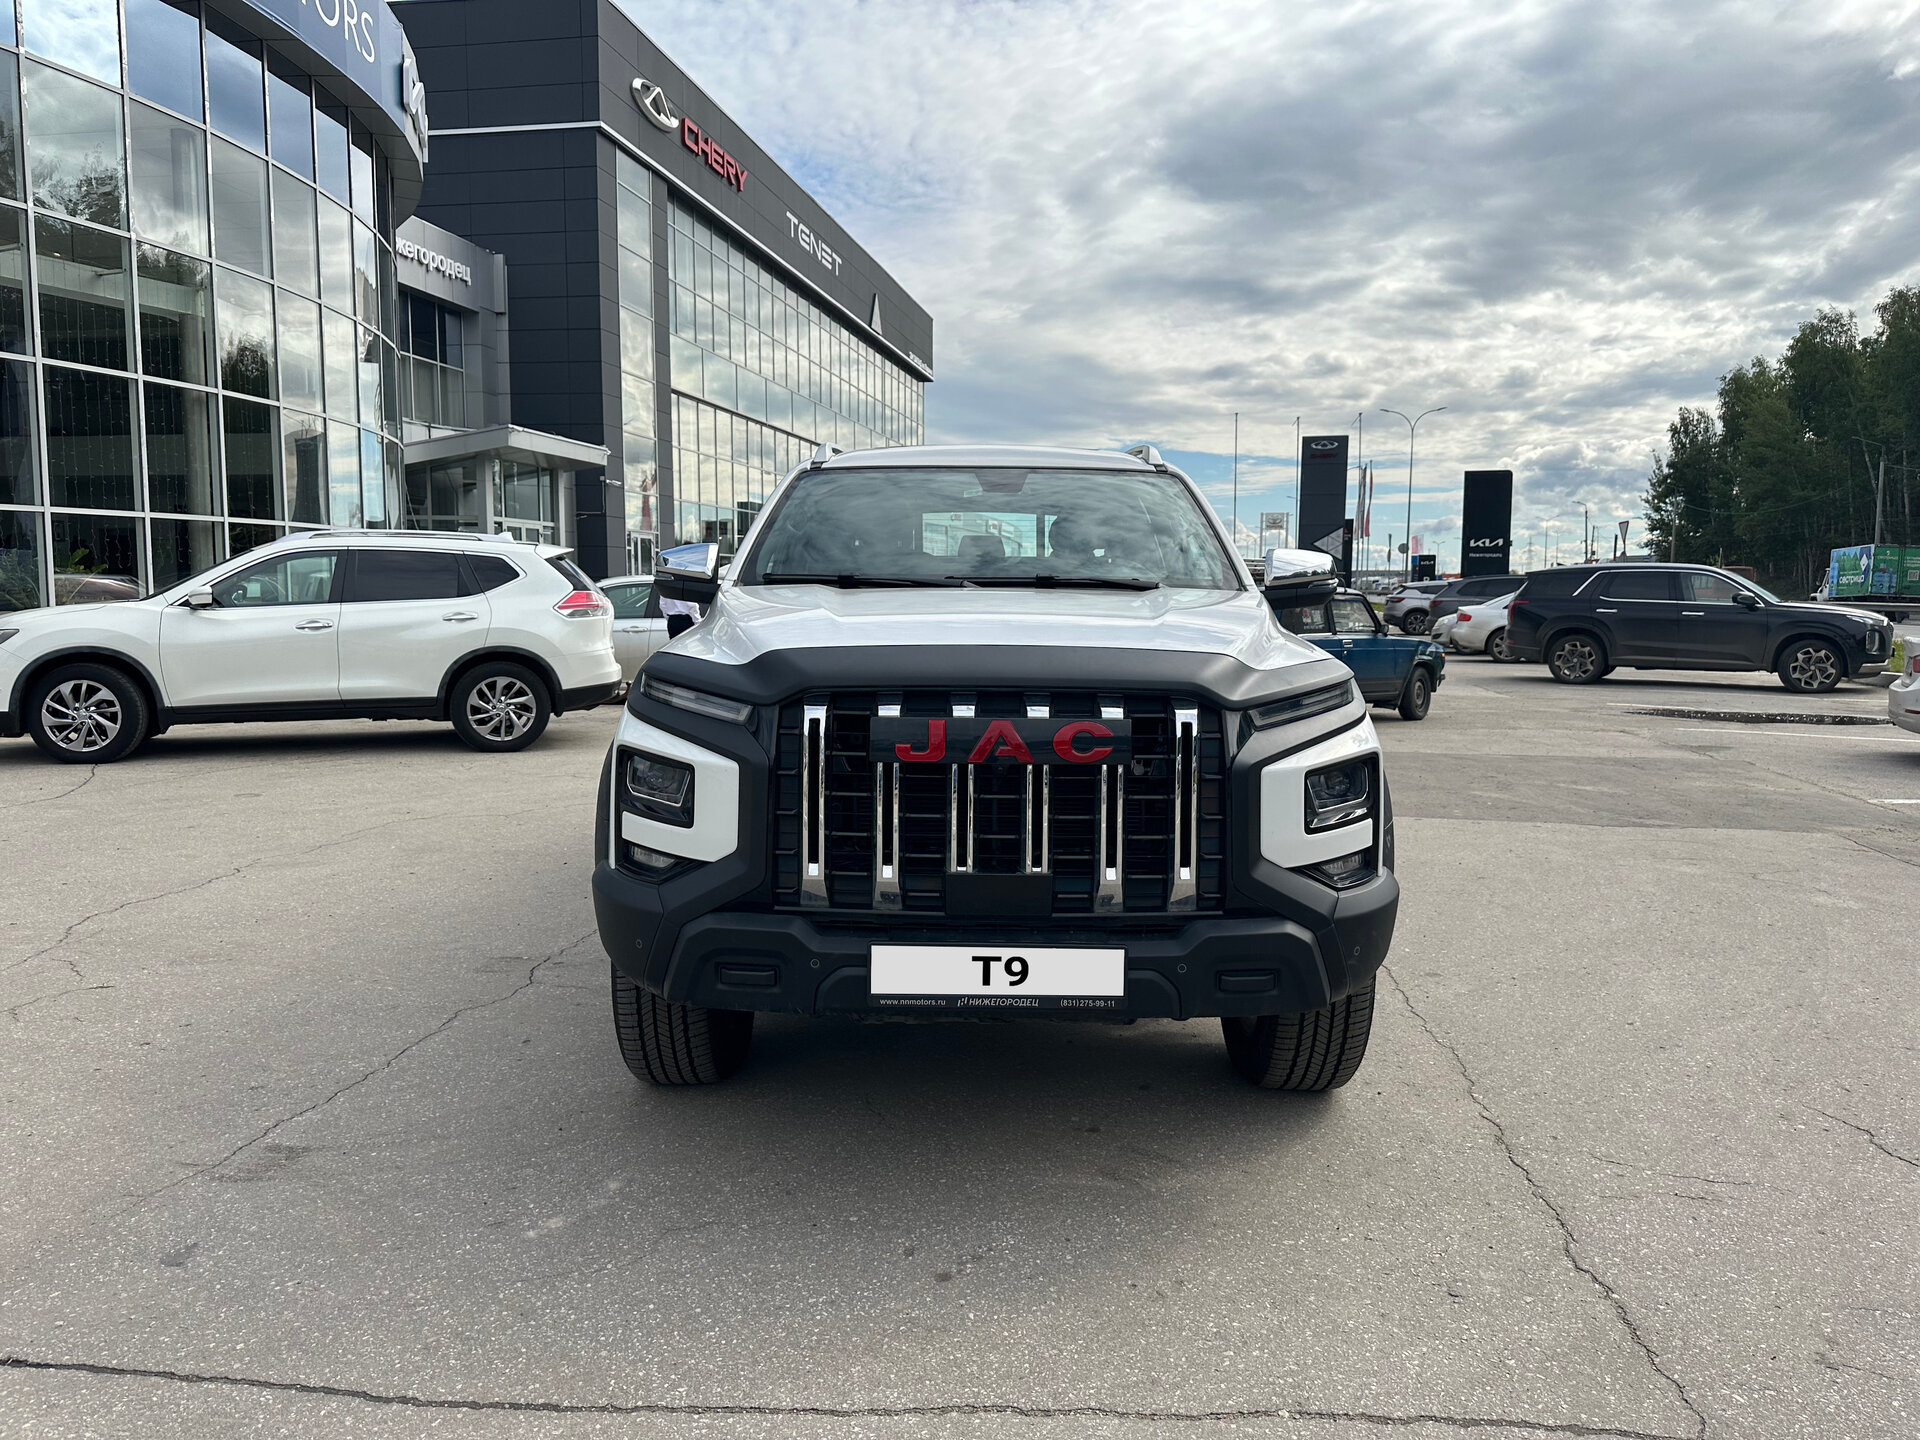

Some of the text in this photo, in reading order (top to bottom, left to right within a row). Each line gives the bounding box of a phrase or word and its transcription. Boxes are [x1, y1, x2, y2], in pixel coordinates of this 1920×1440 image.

[300, 0, 375, 63] ORS
[681, 118, 748, 192] CHERY
[786, 211, 842, 276] TENET
[895, 719, 1114, 763] JAC
[972, 956, 1029, 987] T9
[879, 998, 946, 1006] www.nnmotors.ru
[969, 998, 1039, 1007] НИЖЕГОРОДЕЦ
